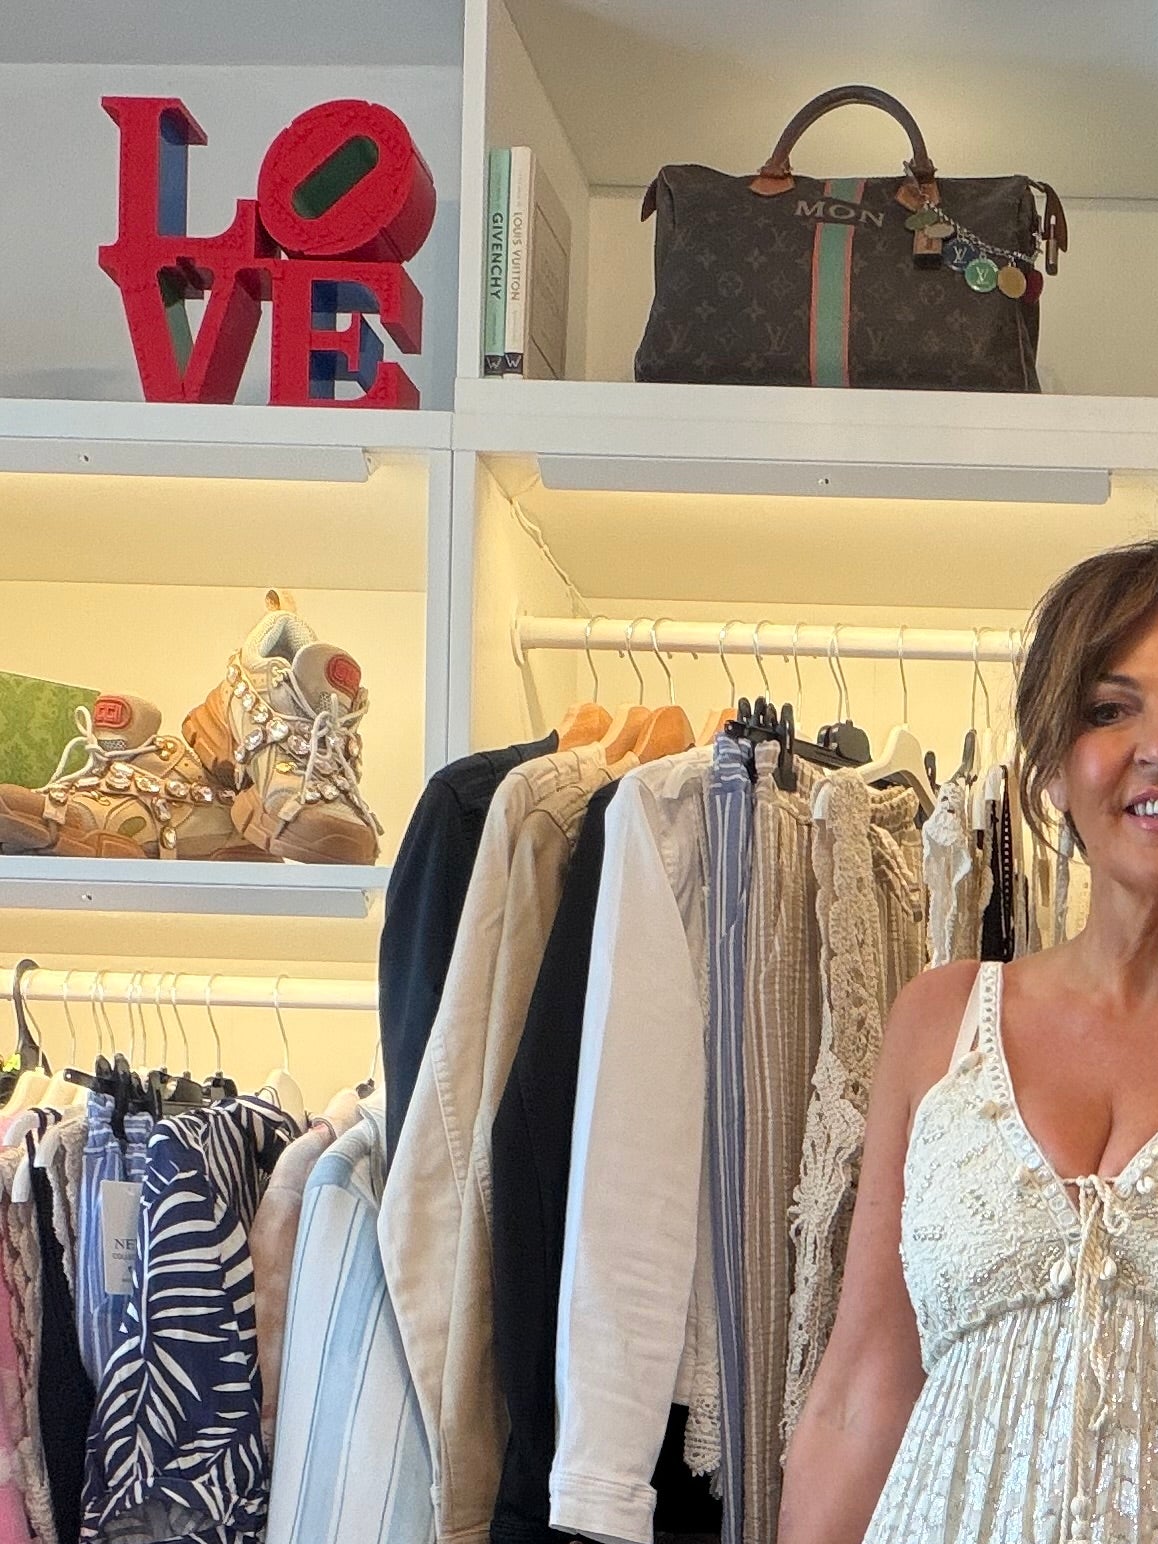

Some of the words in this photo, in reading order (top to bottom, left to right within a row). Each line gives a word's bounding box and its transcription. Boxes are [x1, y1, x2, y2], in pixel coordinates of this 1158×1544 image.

[512, 211, 523, 246] LOUIS
[794, 200, 884, 227] MON
[490, 212, 504, 300] GIVENCHY
[511, 251, 523, 301] VUITTON
